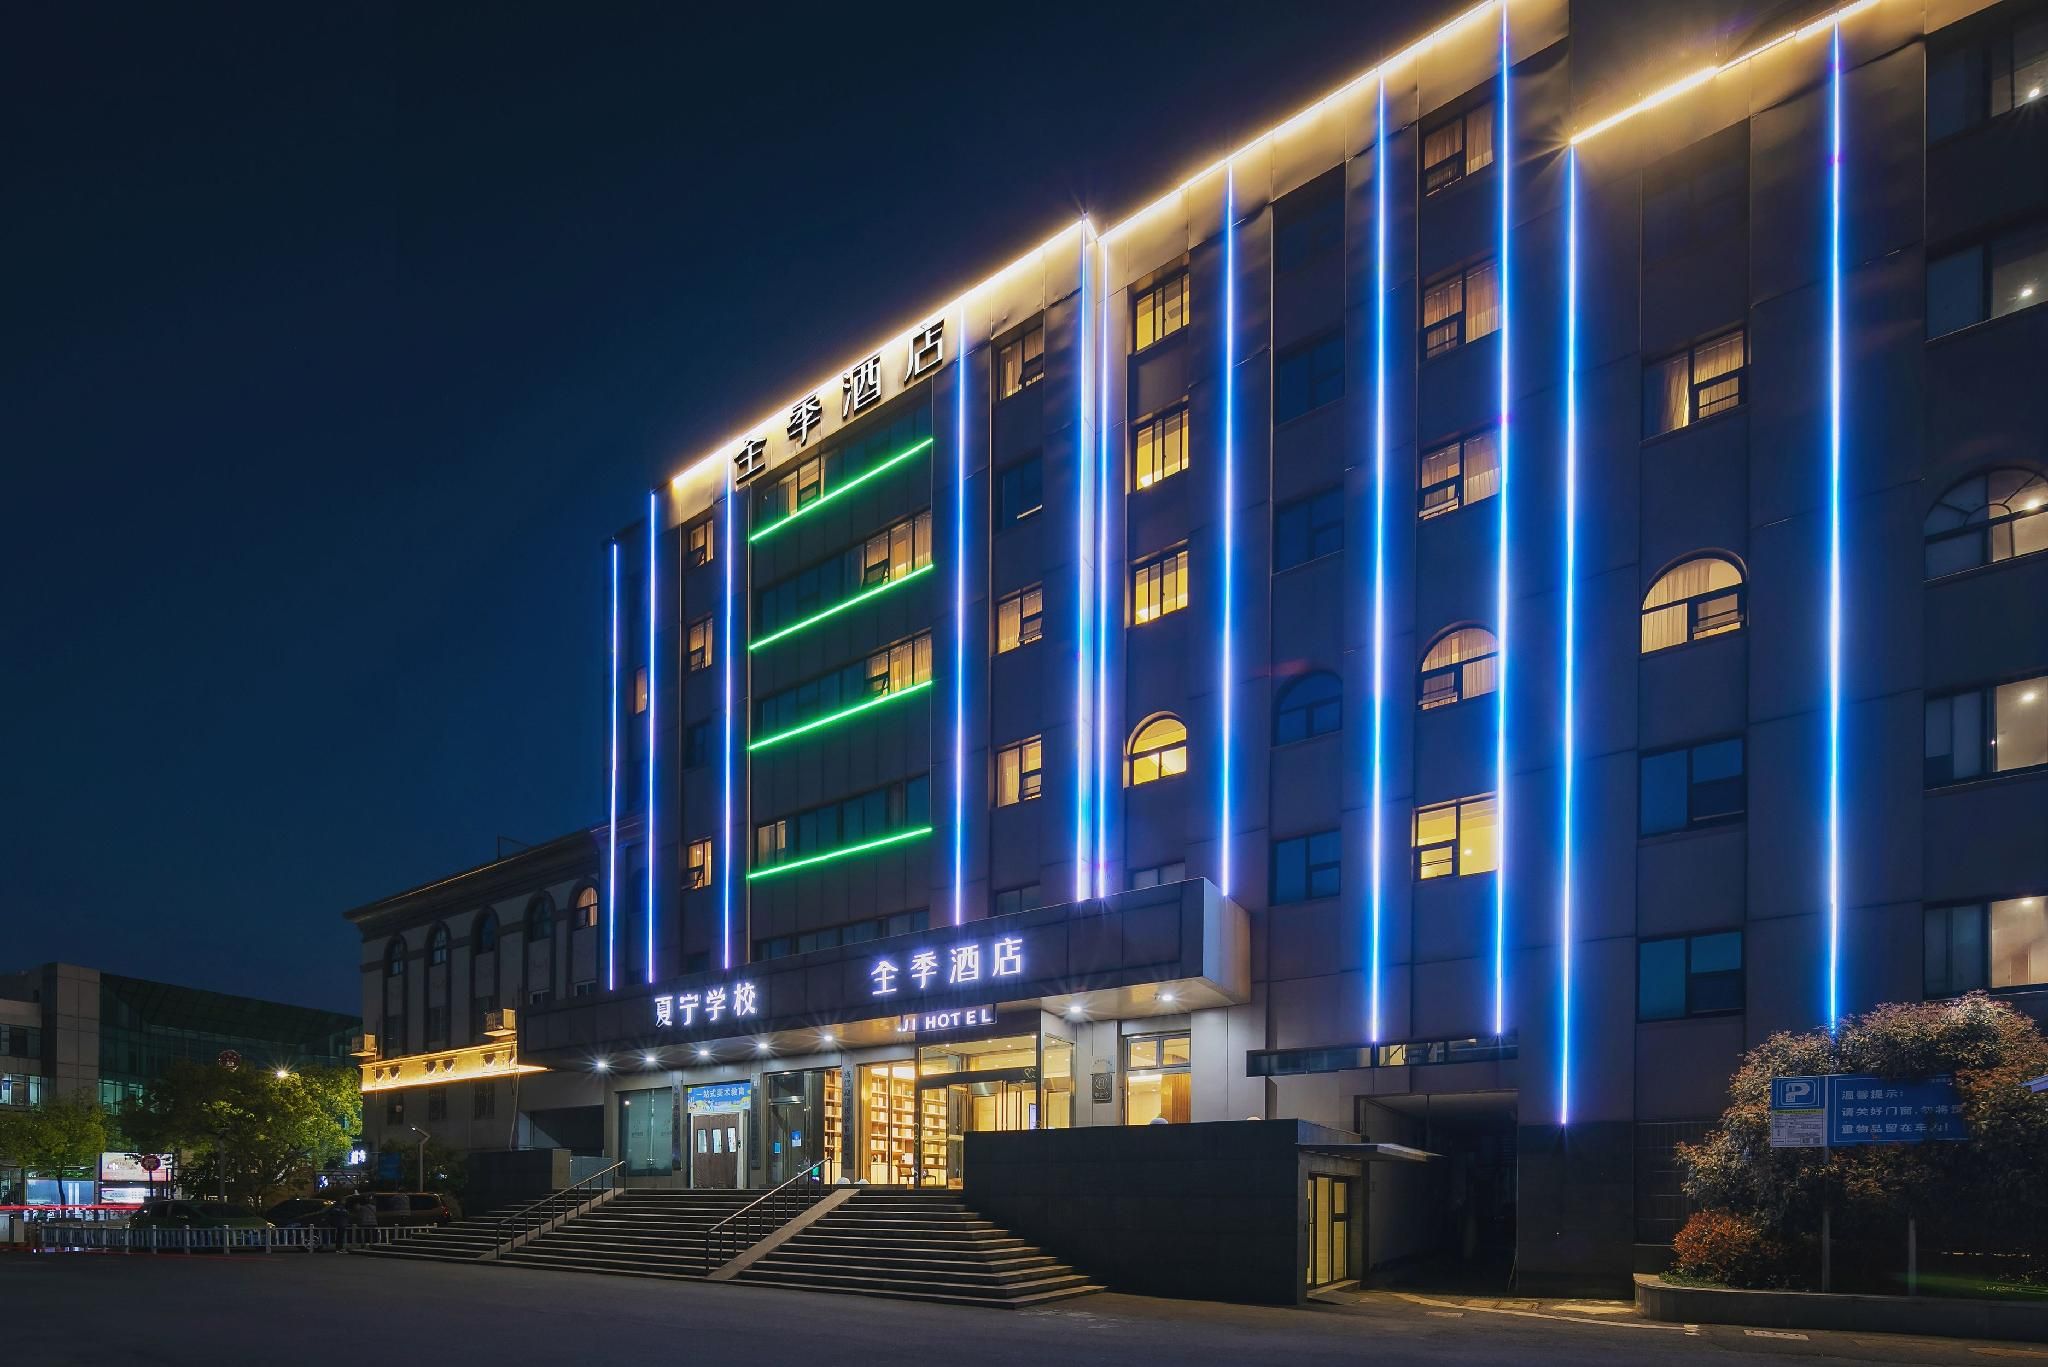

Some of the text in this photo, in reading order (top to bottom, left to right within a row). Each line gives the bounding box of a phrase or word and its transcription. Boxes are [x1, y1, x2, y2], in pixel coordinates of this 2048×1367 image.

[734, 318, 945, 484] 全季酒店
[871, 938, 1023, 996] 全季酒店
[654, 983, 757, 1028] 夏宁学校
[925, 1008, 993, 1030] HOTEL
[1785, 1082, 1811, 1102] P
